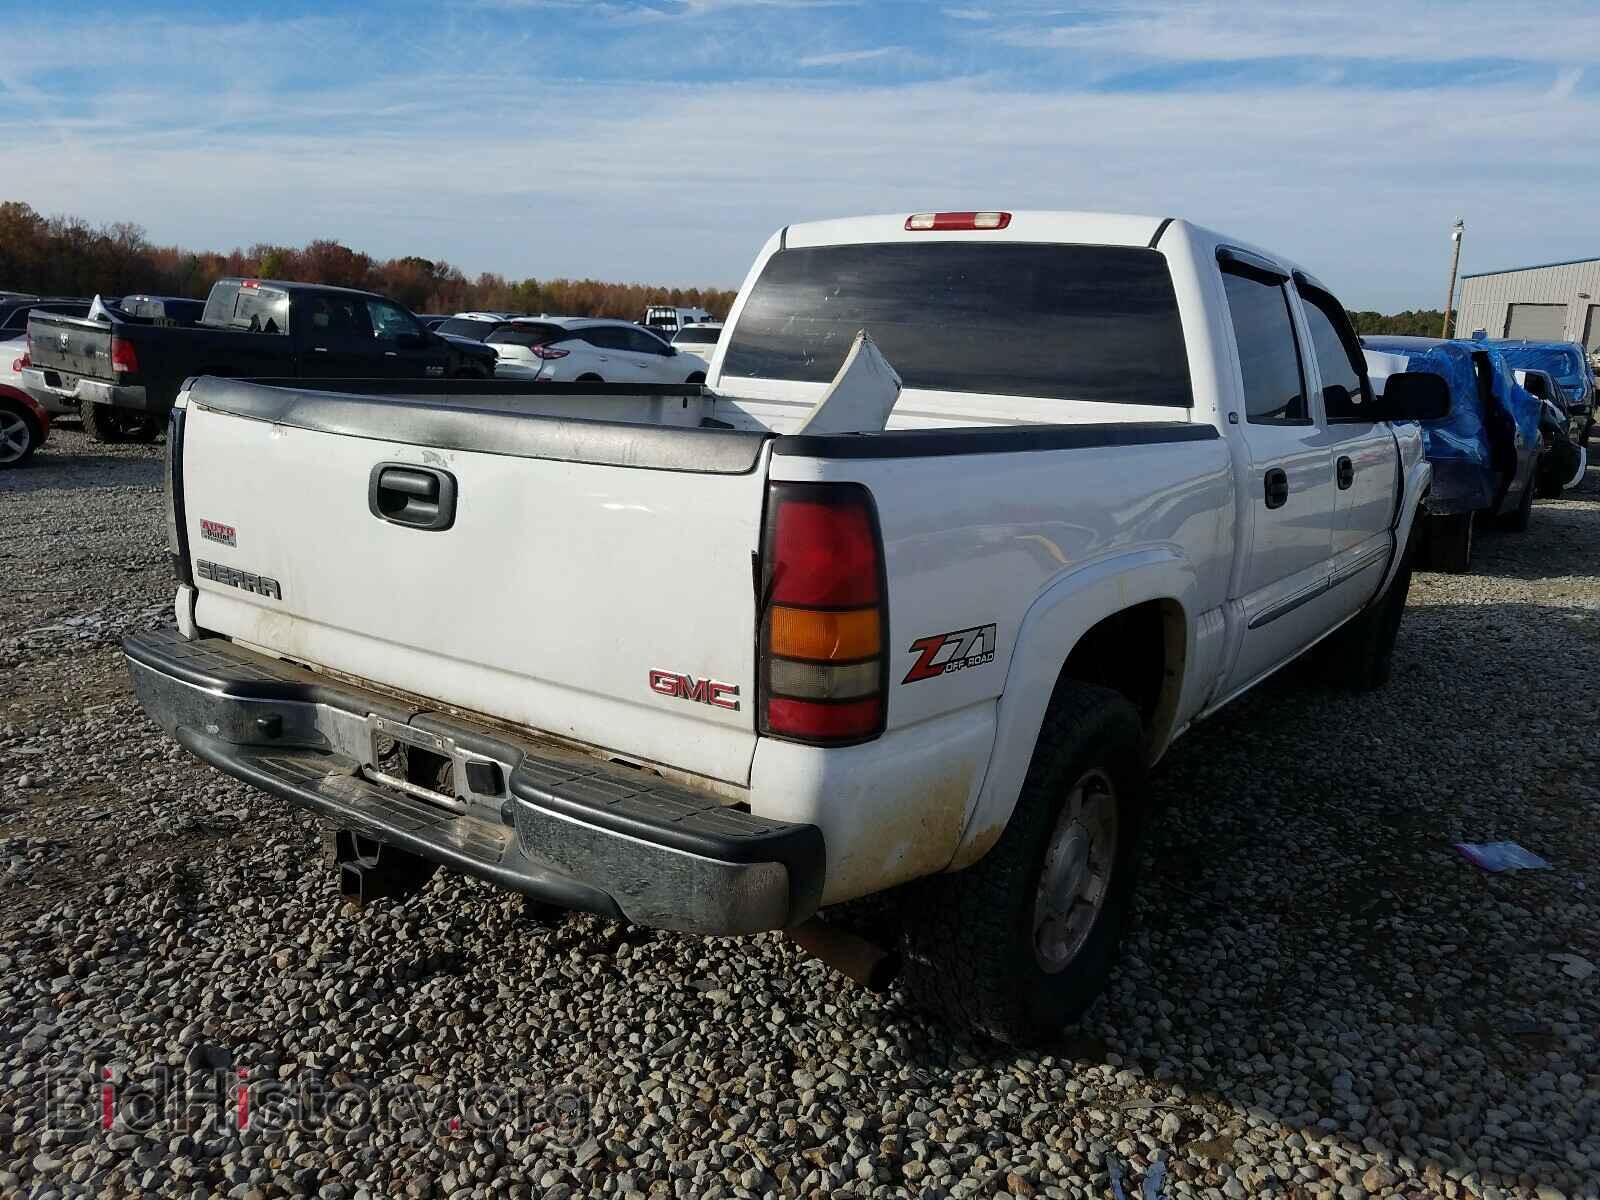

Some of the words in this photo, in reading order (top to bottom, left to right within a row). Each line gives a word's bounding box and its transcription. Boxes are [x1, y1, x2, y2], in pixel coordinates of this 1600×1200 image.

[202, 520, 234, 537] AUTO
[197, 558, 282, 600] SIERRA
[901, 623, 996, 686] Z71
[945, 661, 964, 673] OFF
[967, 652, 994, 668] ROAD
[649, 668, 740, 712] GMC
